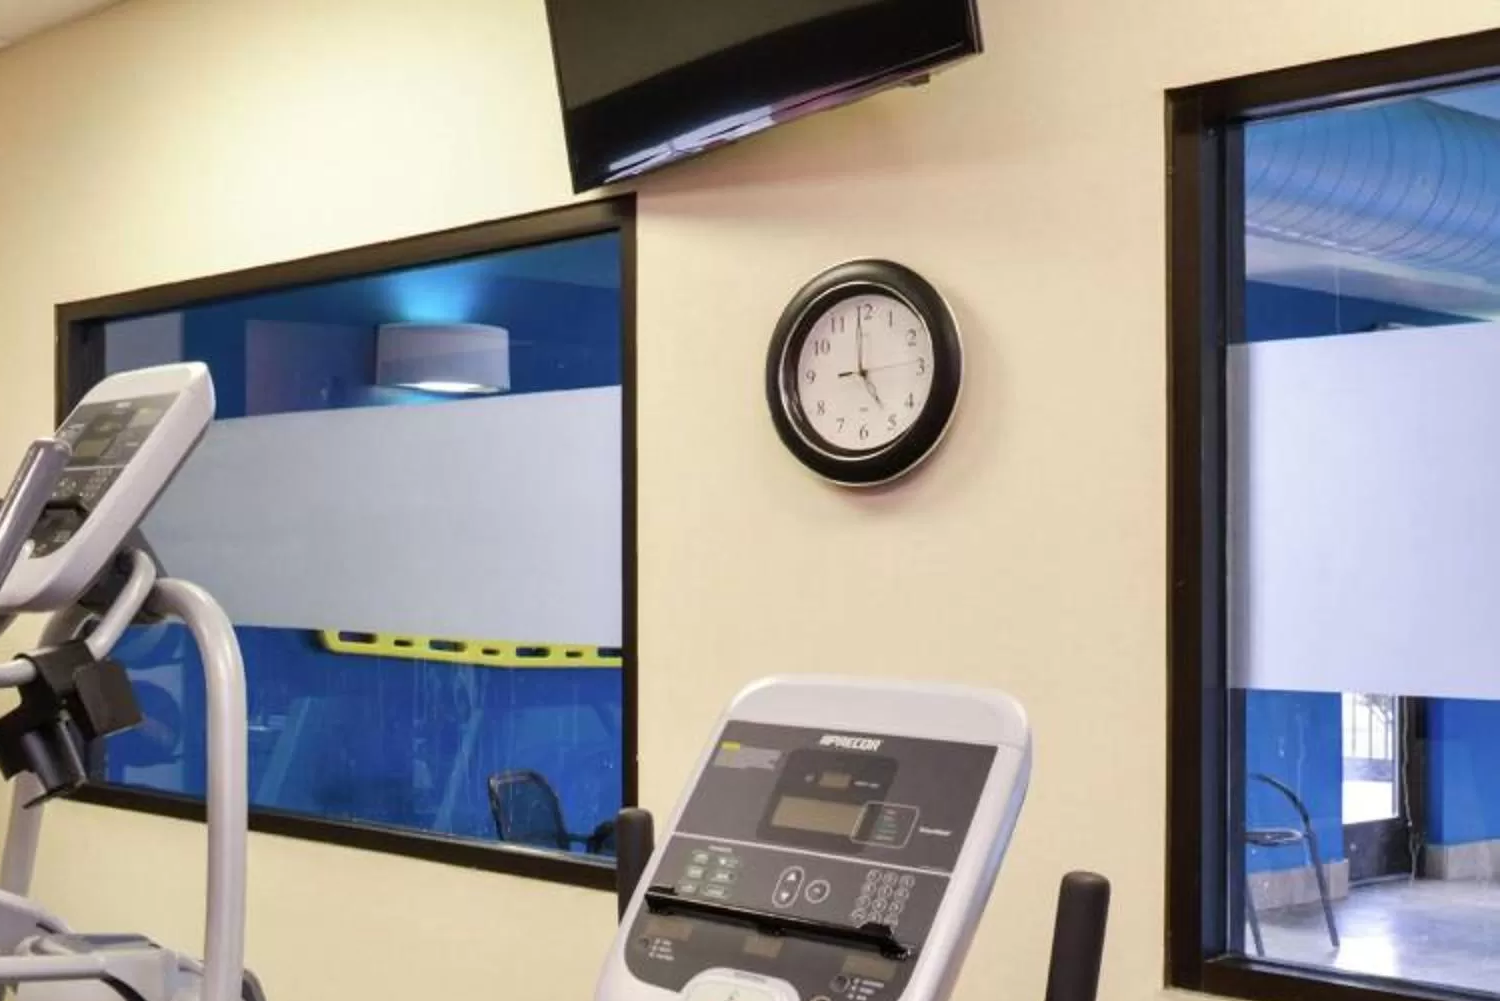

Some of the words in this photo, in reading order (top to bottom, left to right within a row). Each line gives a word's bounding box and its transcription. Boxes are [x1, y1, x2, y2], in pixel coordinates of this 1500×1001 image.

[831, 315, 846, 334] 11
[906, 328, 918, 347] 2
[814, 338, 831, 356] 10
[916, 357, 926, 376] 3
[805, 369, 816, 384] 9
[817, 399, 826, 416] 8
[904, 391, 915, 409] 4
[836, 416, 845, 432] 7
[887, 413, 898, 431] 5
[859, 423, 869, 440] 6
